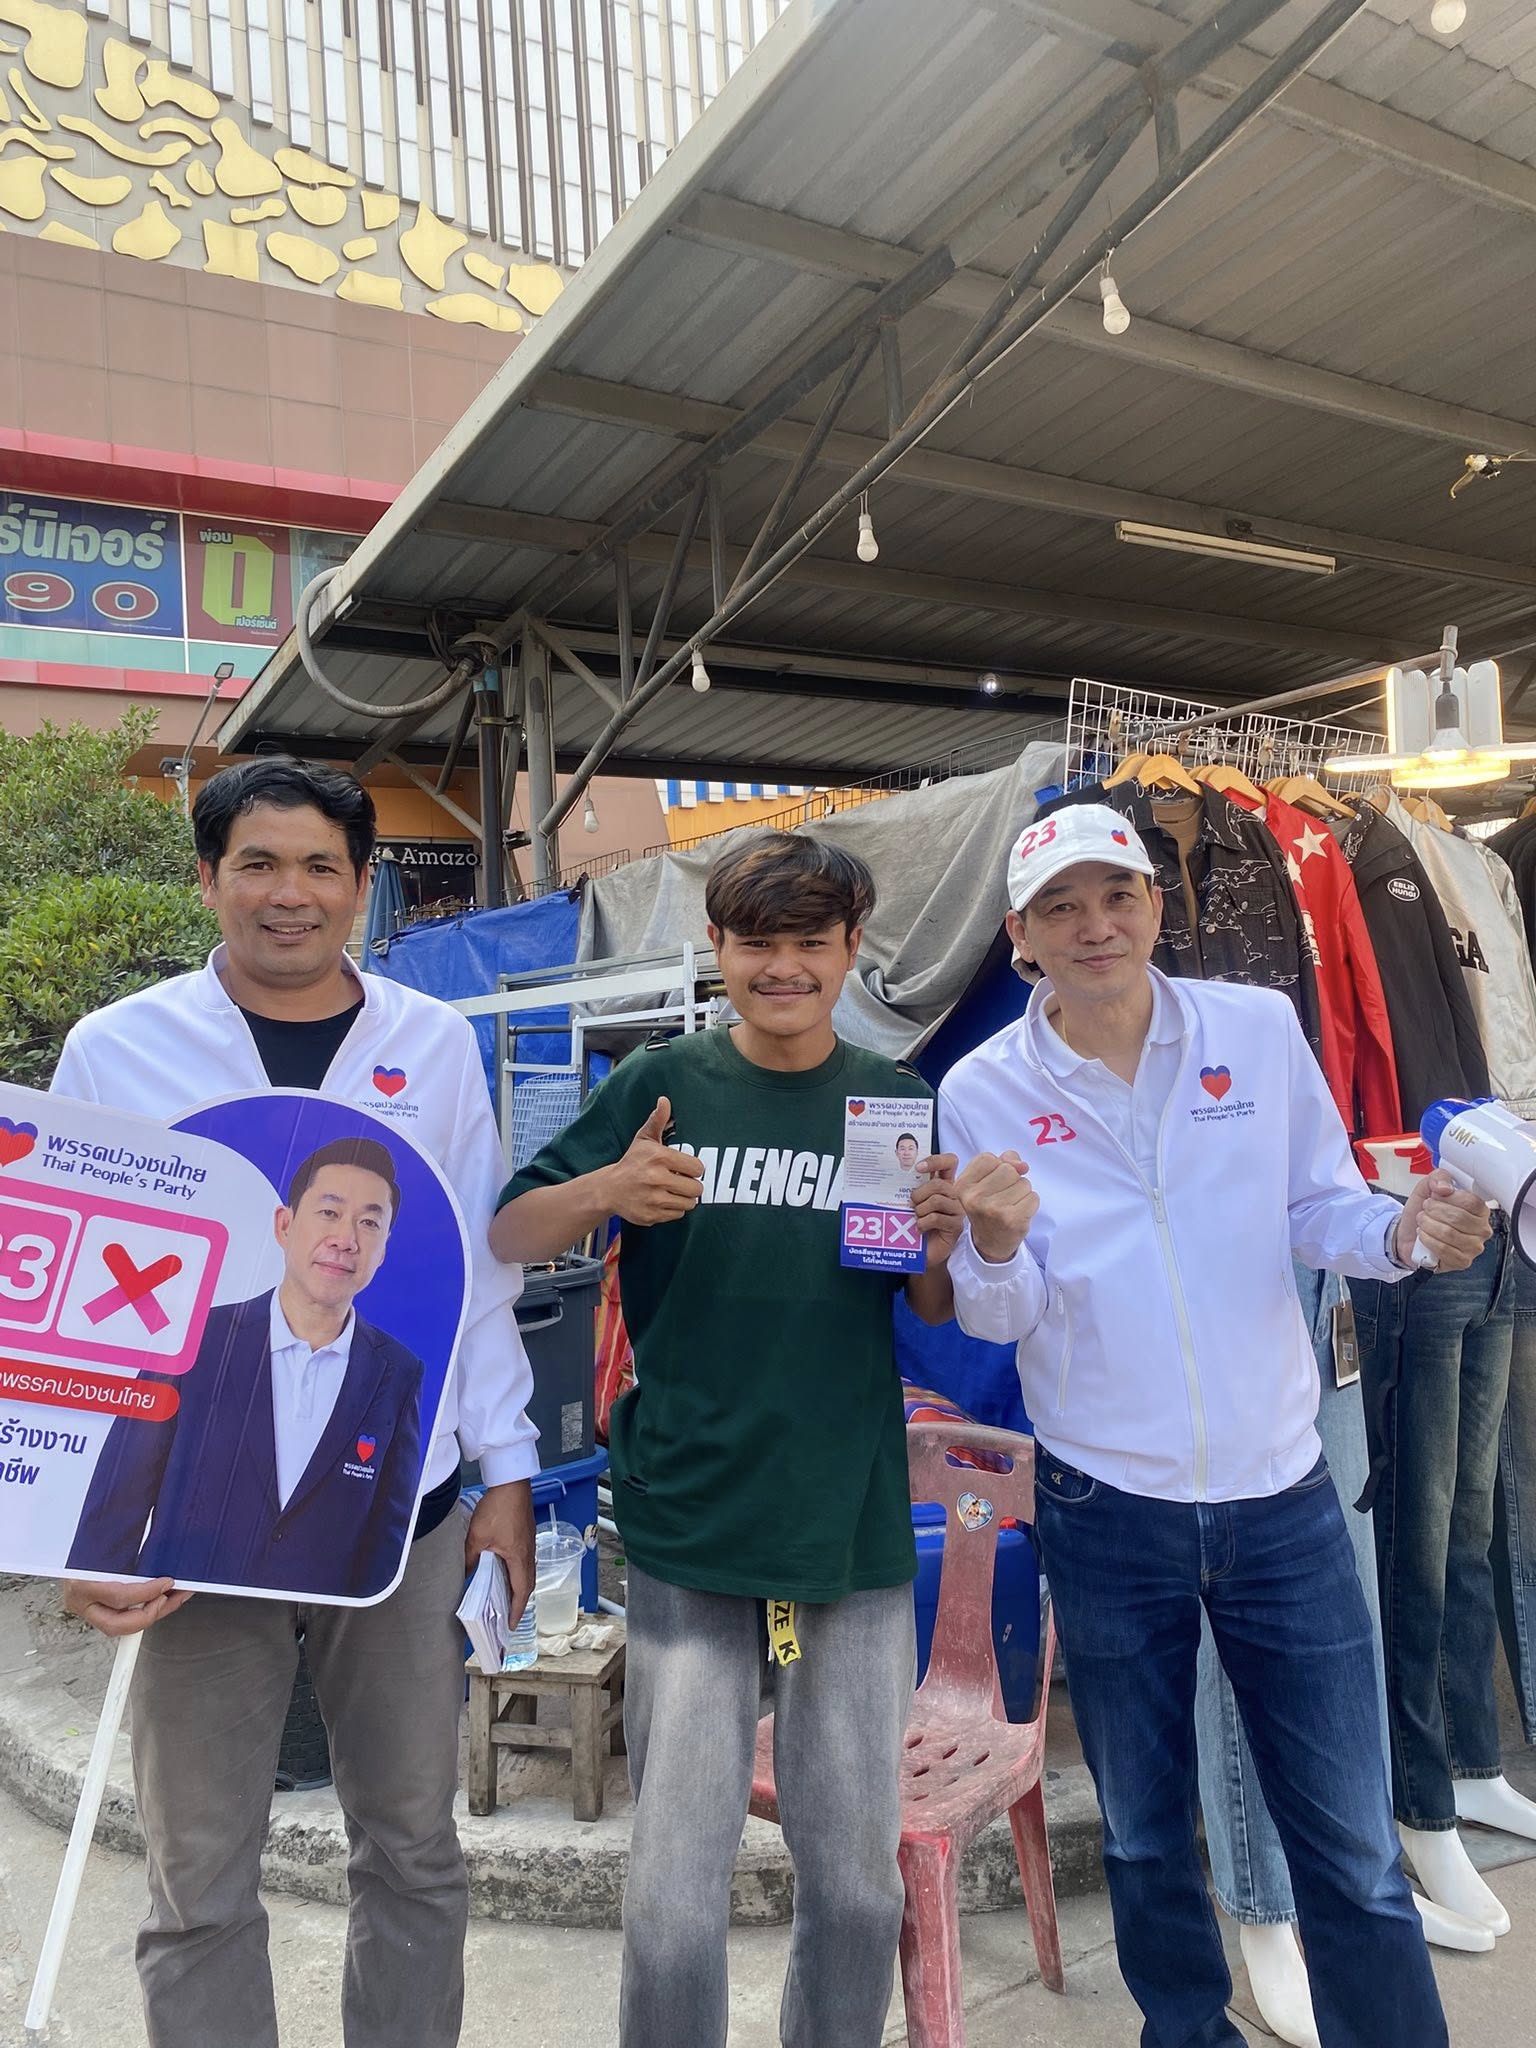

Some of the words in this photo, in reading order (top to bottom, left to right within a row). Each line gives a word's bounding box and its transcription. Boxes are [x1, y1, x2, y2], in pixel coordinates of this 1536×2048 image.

[200, 528, 233, 543] ผ่อน
[1021, 820, 1056, 860] 23
[400, 847, 479, 866] Amazo
[1029, 1113, 1076, 1145] 23
[1449, 1126, 1480, 1147] JMF
[48, 1135, 207, 1183] พรรคปวงชนไทย
[42, 1153, 76, 1173] Thai
[153, 1178, 197, 1201] Party
[848, 1215, 882, 1240] 23
[0, 1233, 56, 1301] 3
[0, 1372, 156, 1409] พรรคปวงชนไทย
[0, 1418, 87, 1454] ร้างงาน
[775, 1600, 790, 1631] ZE
[779, 1640, 796, 1660] K
